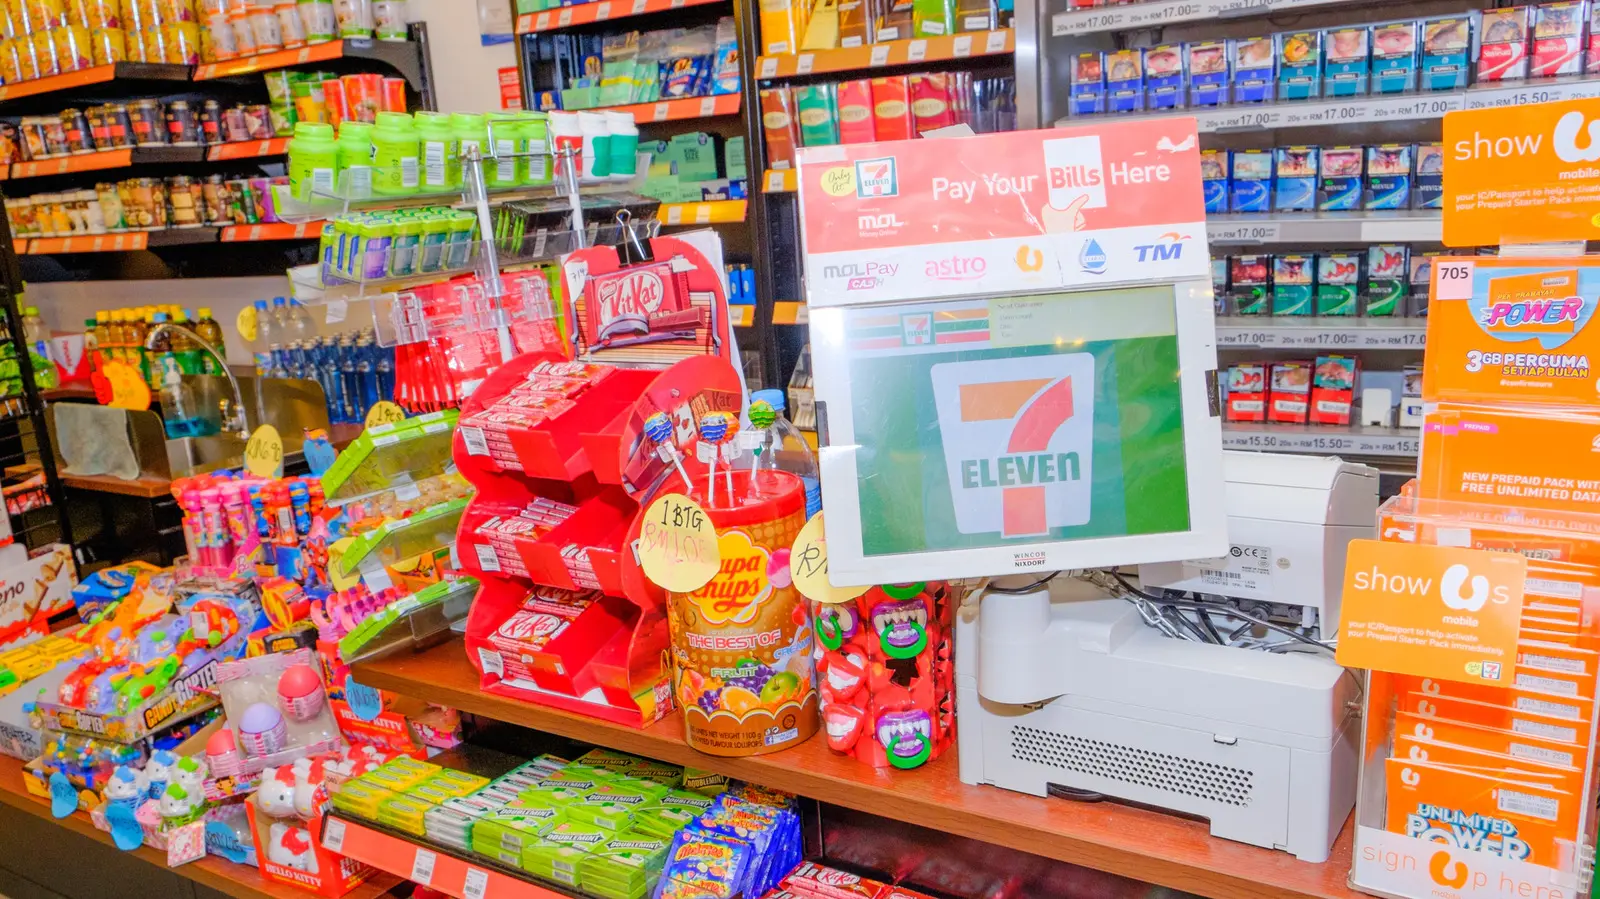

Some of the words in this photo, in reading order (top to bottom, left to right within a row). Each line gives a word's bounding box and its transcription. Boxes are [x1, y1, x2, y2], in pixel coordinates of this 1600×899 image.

[1455, 131, 1543, 160] show
[932, 177, 976, 204] Pay
[982, 173, 1039, 196] Your
[1050, 165, 1101, 189] Bills
[1110, 162, 1170, 186] Here
[1456, 192, 1474, 202] your
[1456, 202, 1475, 212] your
[1548, 196, 1572, 204] Pack
[1132, 243, 1183, 262] TM
[925, 255, 987, 278] astro
[1440, 267, 1468, 280] 705
[611, 275, 658, 318] KitKat
[1488, 297, 1584, 326] POWER
[1464, 350, 1502, 374] 3GB
[1504, 354, 1589, 370] PERCUMA
[1502, 366, 1546, 377] SETIAP
[1547, 367, 1588, 378] BULAN
[1464, 423, 1491, 432] PREPAID
[1462, 472, 1490, 482] NEW
[1491, 474, 1541, 486] PREPAID
[1544, 478, 1574, 488] PACK
[1577, 480, 1600, 490] WIT
[1461, 482, 1494, 494] FREE
[1497, 485, 1570, 500] UNLIMITED
[661, 500, 670, 526] 1
[672, 503, 704, 532] BTG
[1014, 551, 1046, 560] WINCOR
[1014, 559, 1047, 568] NIXDORF
[1354, 566, 1433, 596] show
[504, 614, 558, 638] KitKat
[1442, 614, 1480, 628] mobile
[686, 632, 714, 648] THE
[714, 633, 758, 650] BEST
[759, 629, 782, 645] OF
[1348, 620, 1366, 630] your
[1368, 622, 1414, 636] IC/Passport
[1416, 628, 1424, 636] to
[1426, 628, 1444, 640] help
[1446, 632, 1479, 642] activate
[1348, 629, 1364, 640] your
[1367, 631, 1397, 642] Prepaid
[1399, 634, 1428, 646] Starter
[1429, 638, 1450, 648] Pack
[710, 666, 758, 678] FRUIT
[374, 718, 402, 732] KITTY
[540, 780, 594, 790] DOUBLEMINT
[587, 794, 644, 804] DOUBLEMINT
[662, 797, 712, 808] DOUBLEMINT
[499, 808, 556, 818] DOUBLEMINT
[1418, 802, 1518, 837] UNLIMITED
[548, 834, 604, 843] DOUBLEMINT
[608, 841, 662, 850] DOUBLEMINT
[264, 862, 294, 878] HELLO
[294, 872, 322, 887] KITTY
[821, 871, 859, 885] KitKat
[1362, 843, 1416, 873] sign
[1500, 872, 1564, 899] here
